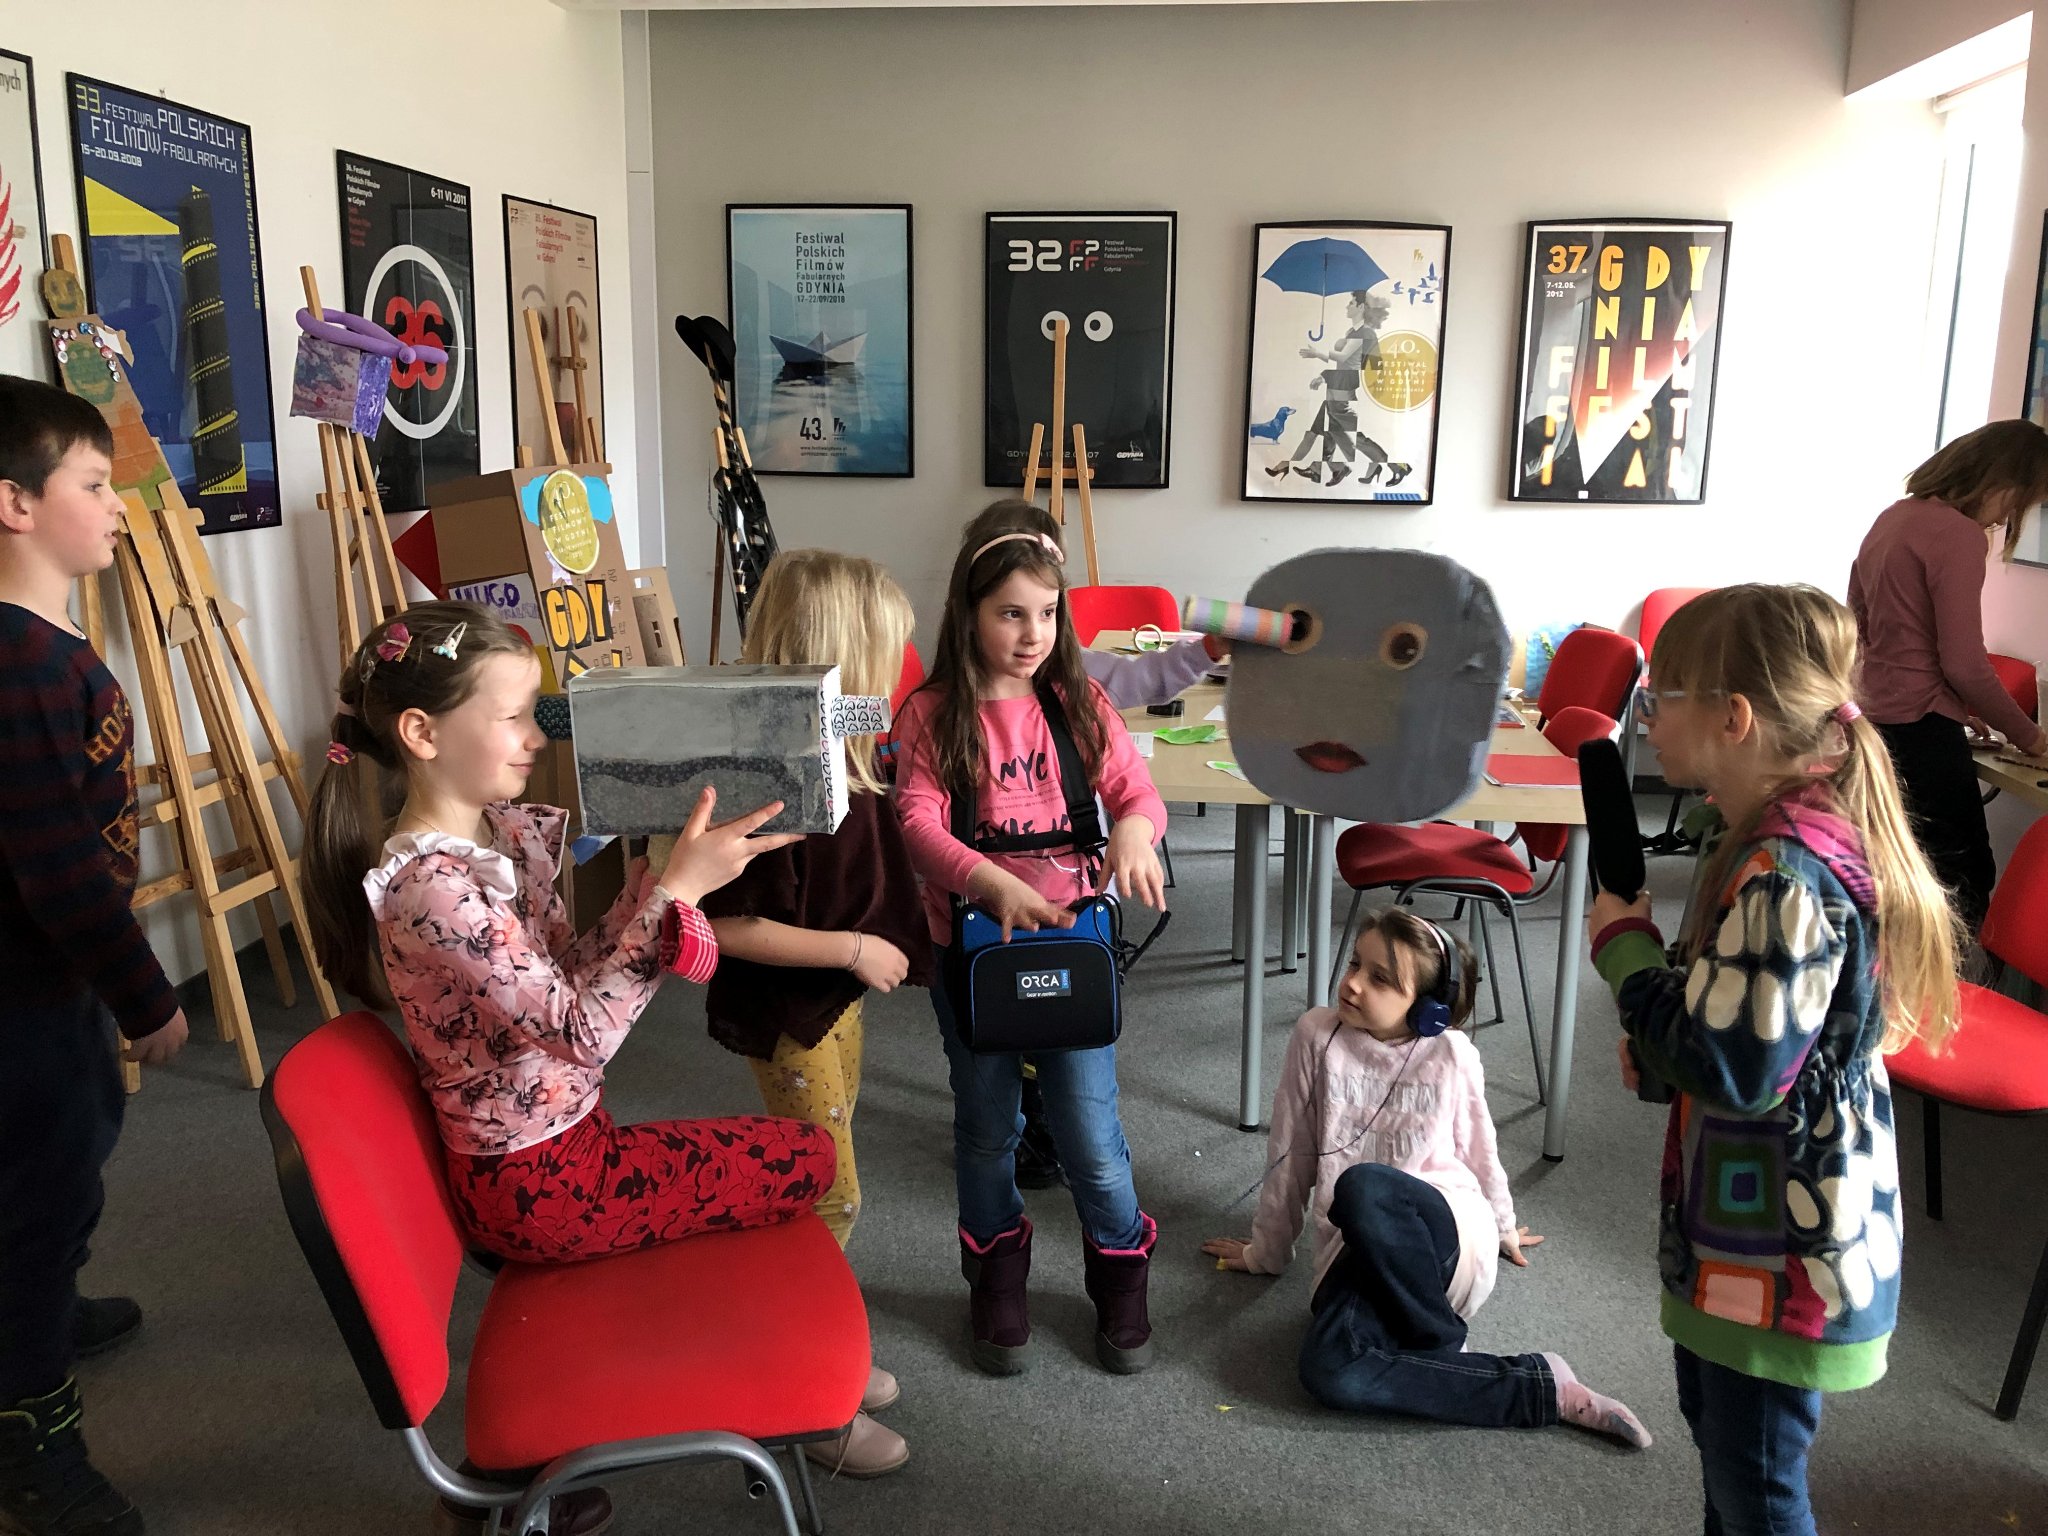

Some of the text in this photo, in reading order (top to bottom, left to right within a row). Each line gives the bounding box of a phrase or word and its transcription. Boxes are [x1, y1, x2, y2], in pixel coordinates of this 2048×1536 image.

[75, 84, 236, 150] 33. FESTIWAL POLSKICH
[81, 143, 143, 167] 15-20.09.2008
[91, 114, 238, 175] FILMÓW FABULARNYCH
[240, 133, 251, 196] FESTIVAL
[430, 187, 466, 206] 6-11 VI 2011
[245, 199, 254, 231] FILM
[795, 231, 845, 244] Festiwal
[249, 234, 258, 279] POLISH
[796, 245, 845, 258] Polskich
[1008, 240, 1062, 271] 32
[1547, 245, 1588, 274] 37.
[796, 258, 844, 271] Filmów
[796, 272, 845, 282] Fabularnych
[796, 281, 845, 293] GDYNIA
[1546, 281, 1576, 290] 7-12.05.
[797, 295, 846, 304] 17-22/09/2018
[1546, 290, 1564, 298] 2012
[385, 296, 446, 391] 36
[1387, 338, 1420, 359] 40.
[1377, 360, 1427, 368] FESTIWAL
[800, 417, 827, 440] 43.
[545, 583, 606, 648] GDY
[1000, 749, 1048, 792] NYC
[1021, 974, 1060, 988] ORCA
